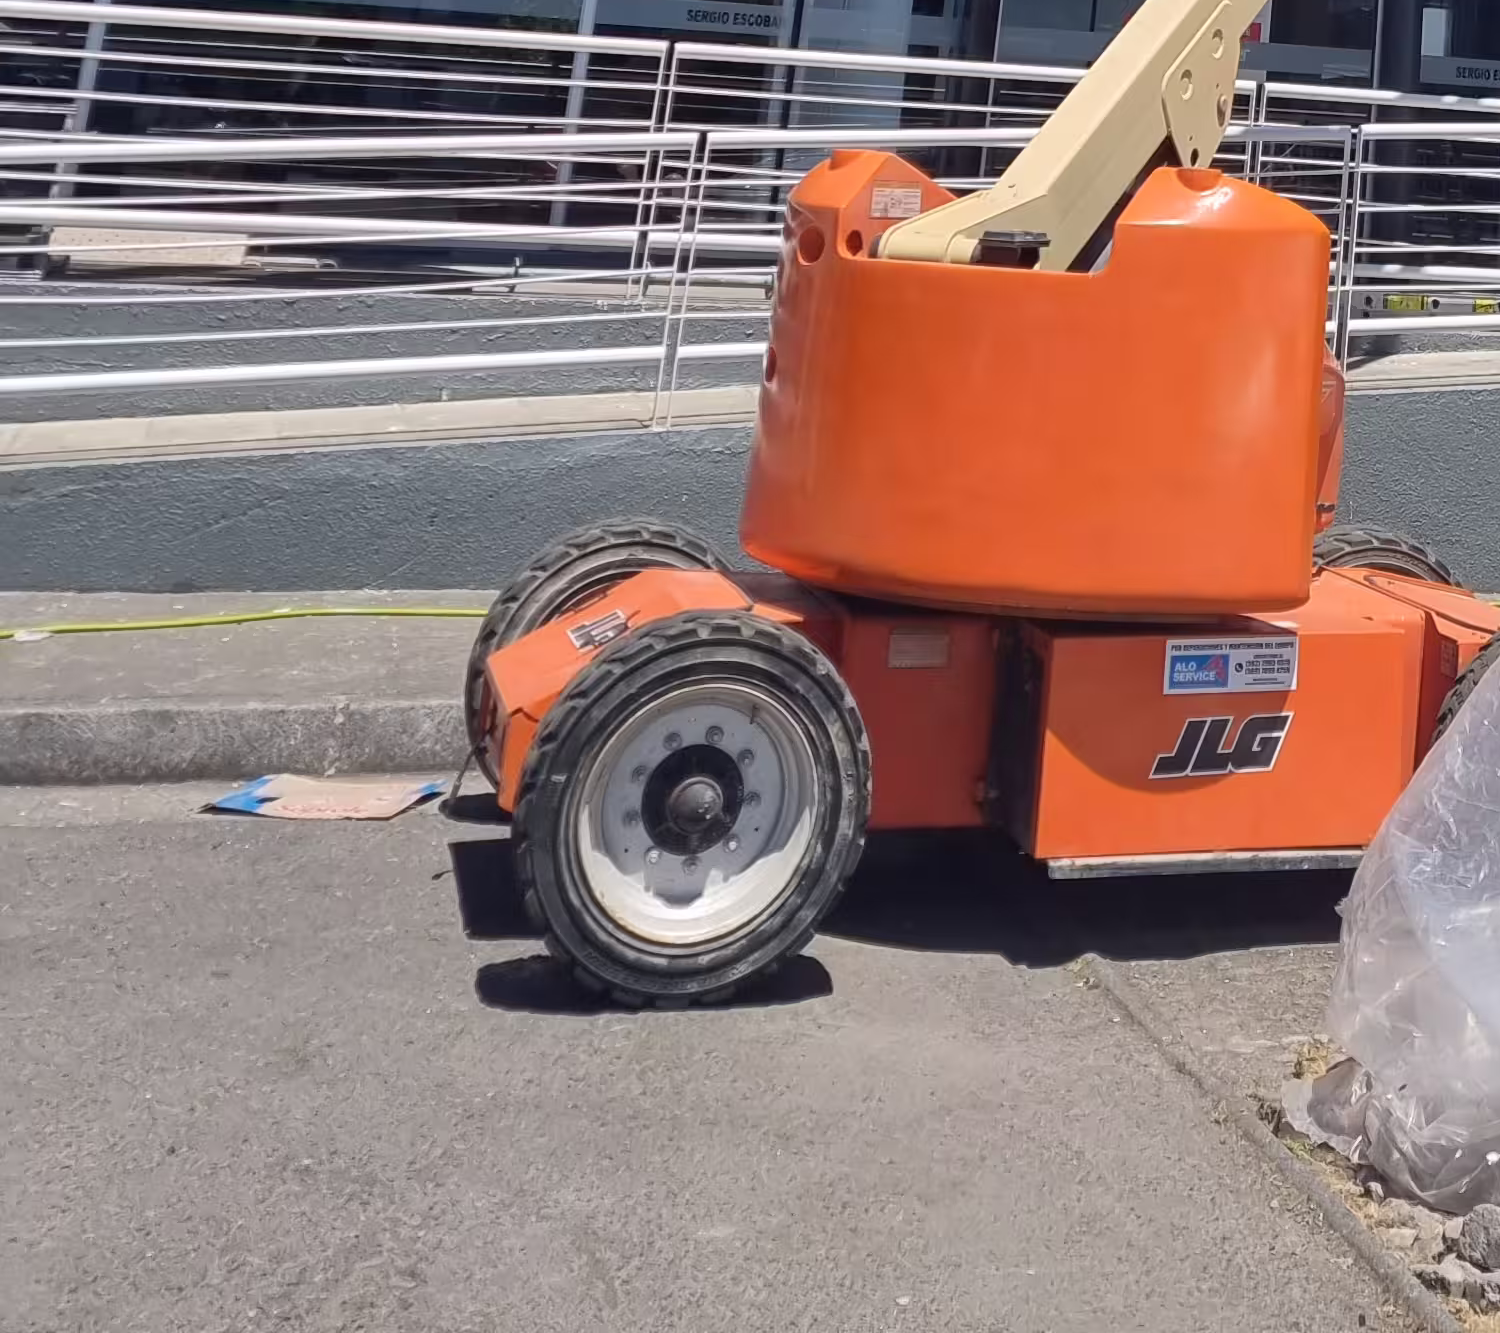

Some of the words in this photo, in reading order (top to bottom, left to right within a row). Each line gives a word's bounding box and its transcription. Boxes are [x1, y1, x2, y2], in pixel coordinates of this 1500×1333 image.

[686, 8, 730, 25] SERGIO
[1455, 65, 1491, 82] SERGIO
[1174, 661, 1197, 672] ALO
[1173, 671, 1217, 682] SERVICE
[1149, 711, 1294, 779] JLG
